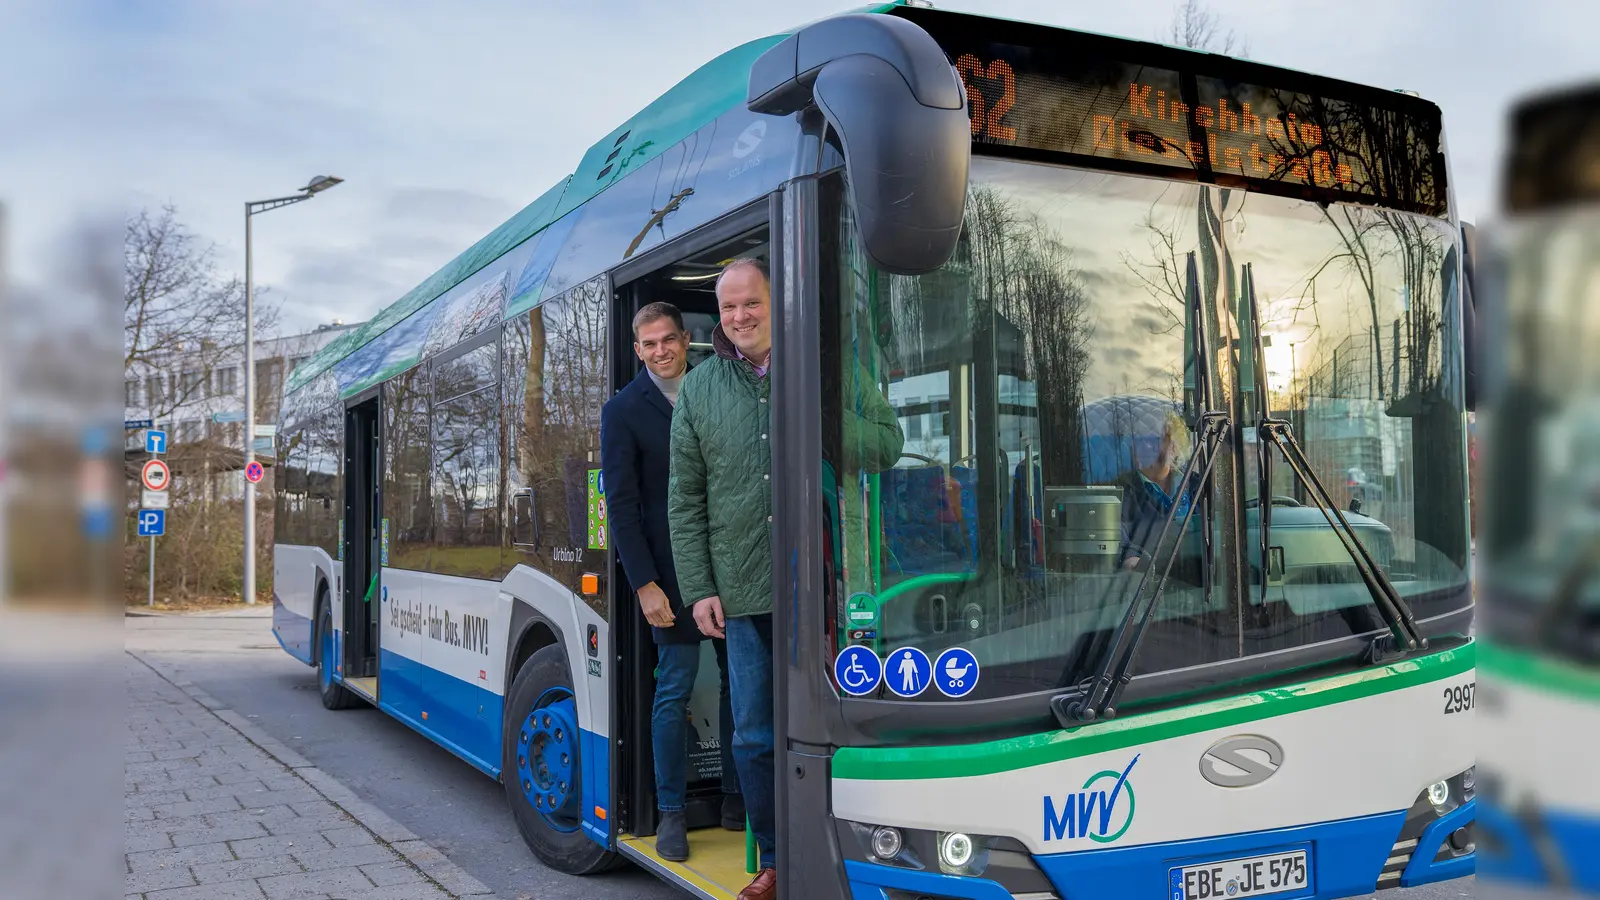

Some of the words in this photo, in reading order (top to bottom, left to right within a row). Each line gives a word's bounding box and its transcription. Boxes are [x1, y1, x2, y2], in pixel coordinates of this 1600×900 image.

[1130, 83, 1322, 145] Kirchheim
[1093, 114, 1352, 185] Dieselstraße
[144, 513, 158, 532] P
[553, 547, 575, 562] Urbino
[575, 548, 583, 562] 12
[857, 597, 867, 610] 4
[390, 597, 399, 628] Sei
[400, 600, 422, 639] gscheid
[428, 604, 442, 641] fahr
[444, 609, 461, 647] Bus.
[463, 614, 489, 656] MVV!
[1443, 682, 1476, 714] 2997
[1043, 753, 1141, 842] MVV
[1184, 867, 1224, 900] EBE
[1240, 862, 1265, 892] JE
[1269, 856, 1306, 888] 575
